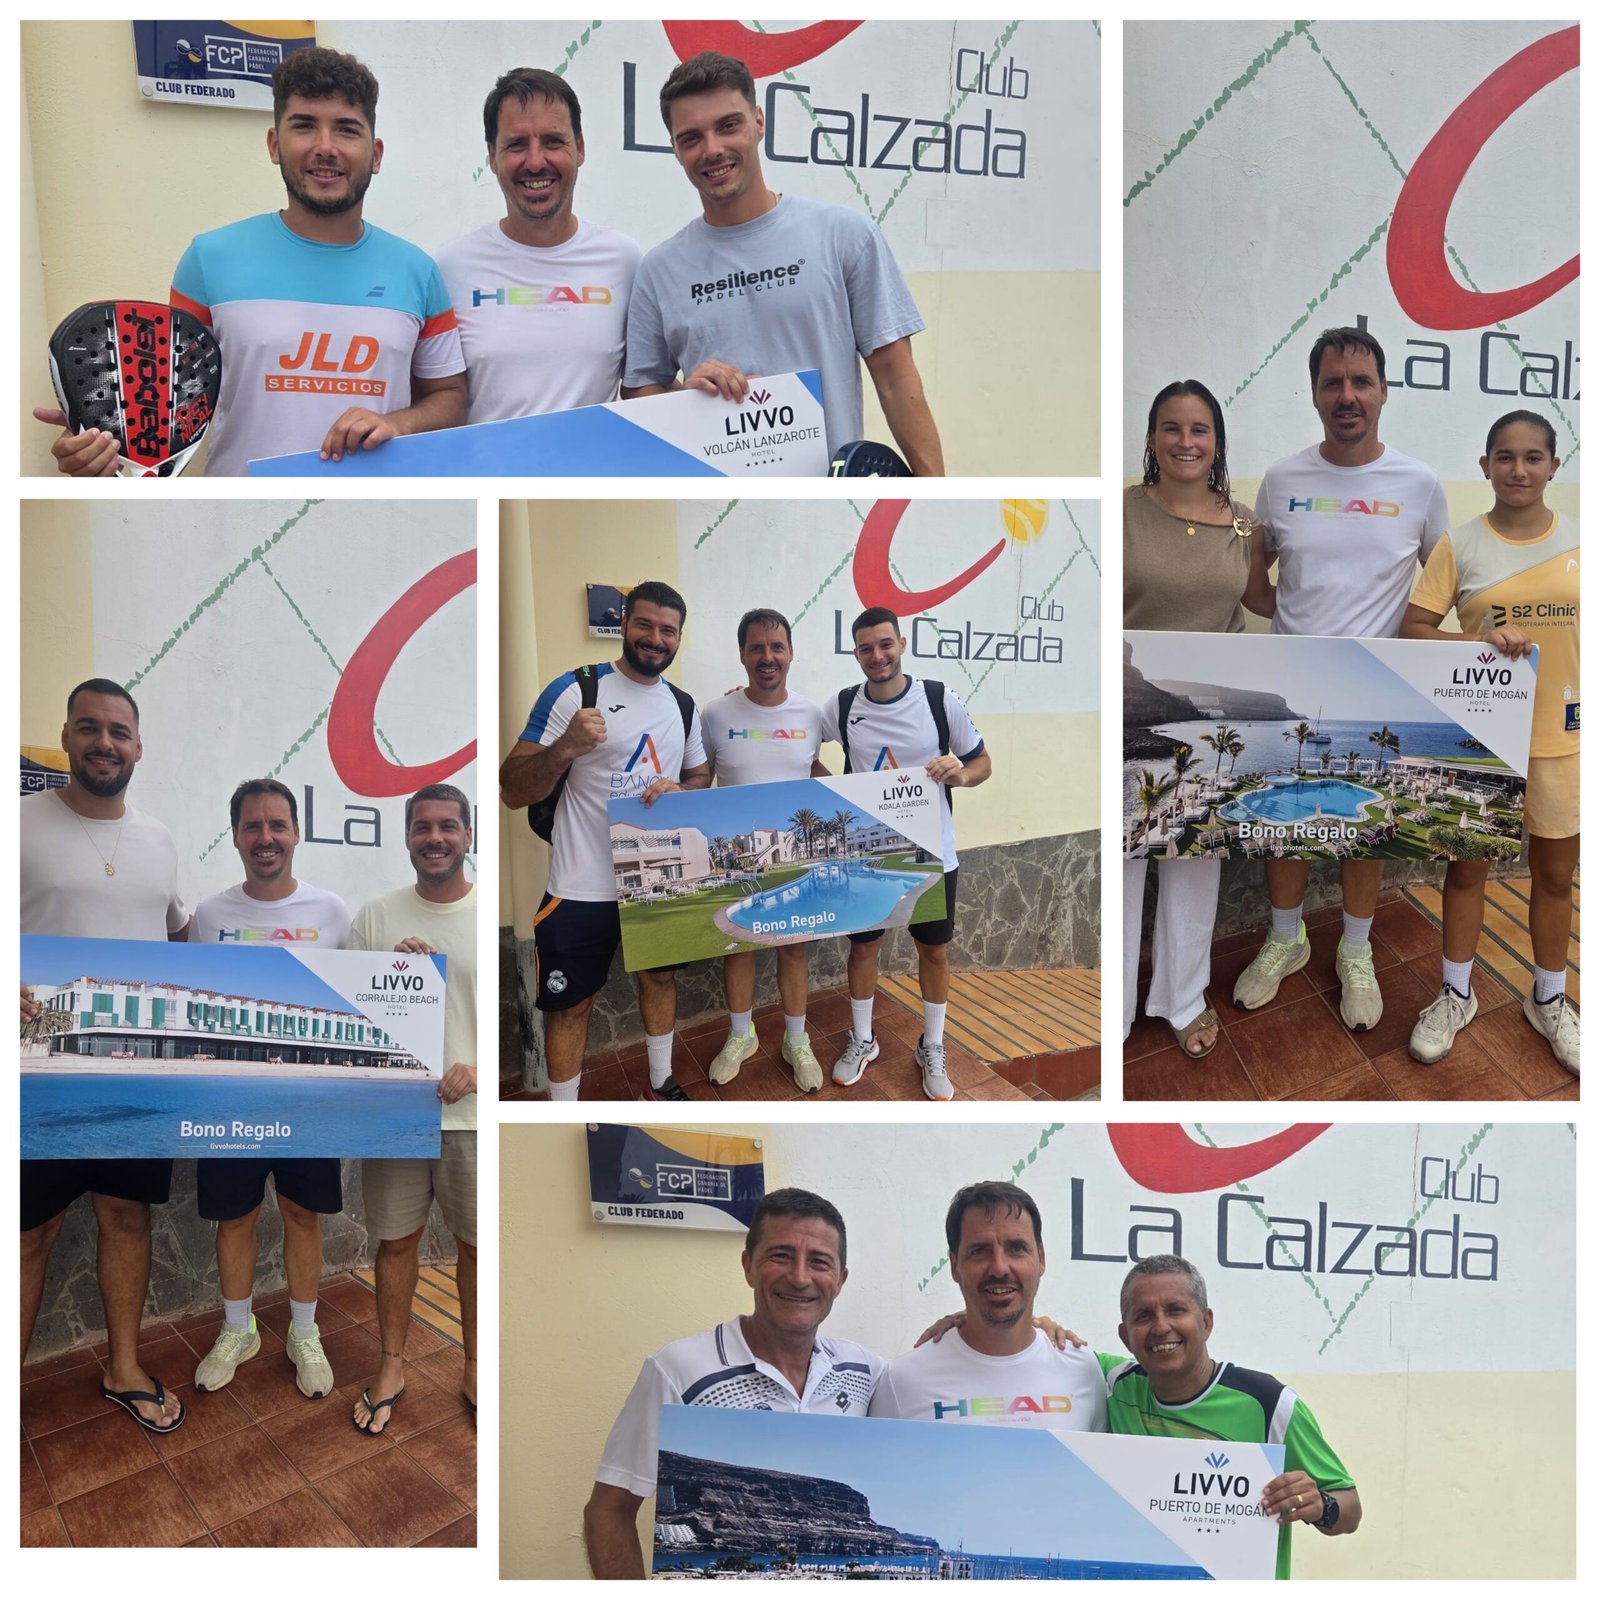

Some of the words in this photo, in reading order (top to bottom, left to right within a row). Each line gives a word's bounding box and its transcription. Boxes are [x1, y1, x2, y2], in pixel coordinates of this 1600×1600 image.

[205, 44, 244, 65] FCP
[248, 54, 271, 63] CANARIA
[956, 47, 1030, 100] Club
[156, 81, 182, 94] CLUB
[185, 84, 236, 99] FEDERADO
[623, 61, 674, 155] L
[764, 81, 1027, 179] Calzada
[472, 286, 612, 308] HEAD
[697, 289, 744, 306] PADEL
[755, 277, 796, 292] CLUB
[278, 331, 380, 373] JLD
[1479, 331, 1580, 401] Cal
[131, 308, 160, 458] Babolat
[268, 378, 382, 394] SERVICIOS
[725, 405, 794, 436] LIVVO
[703, 437, 750, 456] VOLCÁN
[754, 426, 820, 449] LANZAROTE
[751, 449, 776, 458] HOTEL
[1288, 497, 1400, 518] HEAD
[1020, 595, 1064, 622] Club
[1512, 604, 1532, 618] S2
[1536, 603, 1576, 617] Clinic
[834, 609, 854, 655] L
[911, 616, 1063, 664] Calzada
[1452, 667, 1512, 686] LIVVO
[1434, 687, 1474, 698] PUERTO
[1476, 689, 1490, 699] DE
[1492, 688, 1528, 700] MOGÁN
[728, 728, 807, 740] HEAD
[883, 784, 923, 801] LIVVO
[878, 802, 901, 811] KOALA
[901, 799, 929, 808] GARDEN
[304, 784, 382, 848] La
[1238, 822, 1287, 839] Bono
[1293, 822, 1358, 842] Regalo
[1270, 844, 1325, 852] livvohotels.com
[752, 920, 787, 934] Bono
[790, 911, 836, 928] Regalo
[218, 928, 319, 942] HEAD
[371, 974, 424, 991] LIVVO
[355, 993, 408, 1003] CORRALEJO
[409, 995, 439, 1004] BEACH
[180, 1120, 226, 1137] Bono
[231, 1120, 291, 1141] Regalo
[210, 1142, 261, 1150] livvohotels.com
[656, 1171, 693, 1190] FCP
[1420, 1156, 1500, 1205] Club
[608, 1205, 633, 1217] CLUB
[635, 1207, 684, 1220] FEDERADO
[1070, 1177, 1183, 1263] La
[1217, 1192, 1499, 1281] Calzada
[933, 1395, 1072, 1420] HEAD
[1173, 1472, 1250, 1498] LIVVO
[1149, 1499, 1201, 1513] PUERTO
[1204, 1502, 1222, 1515] DE
[1182, 1516, 1237, 1525] APARTMENTS
